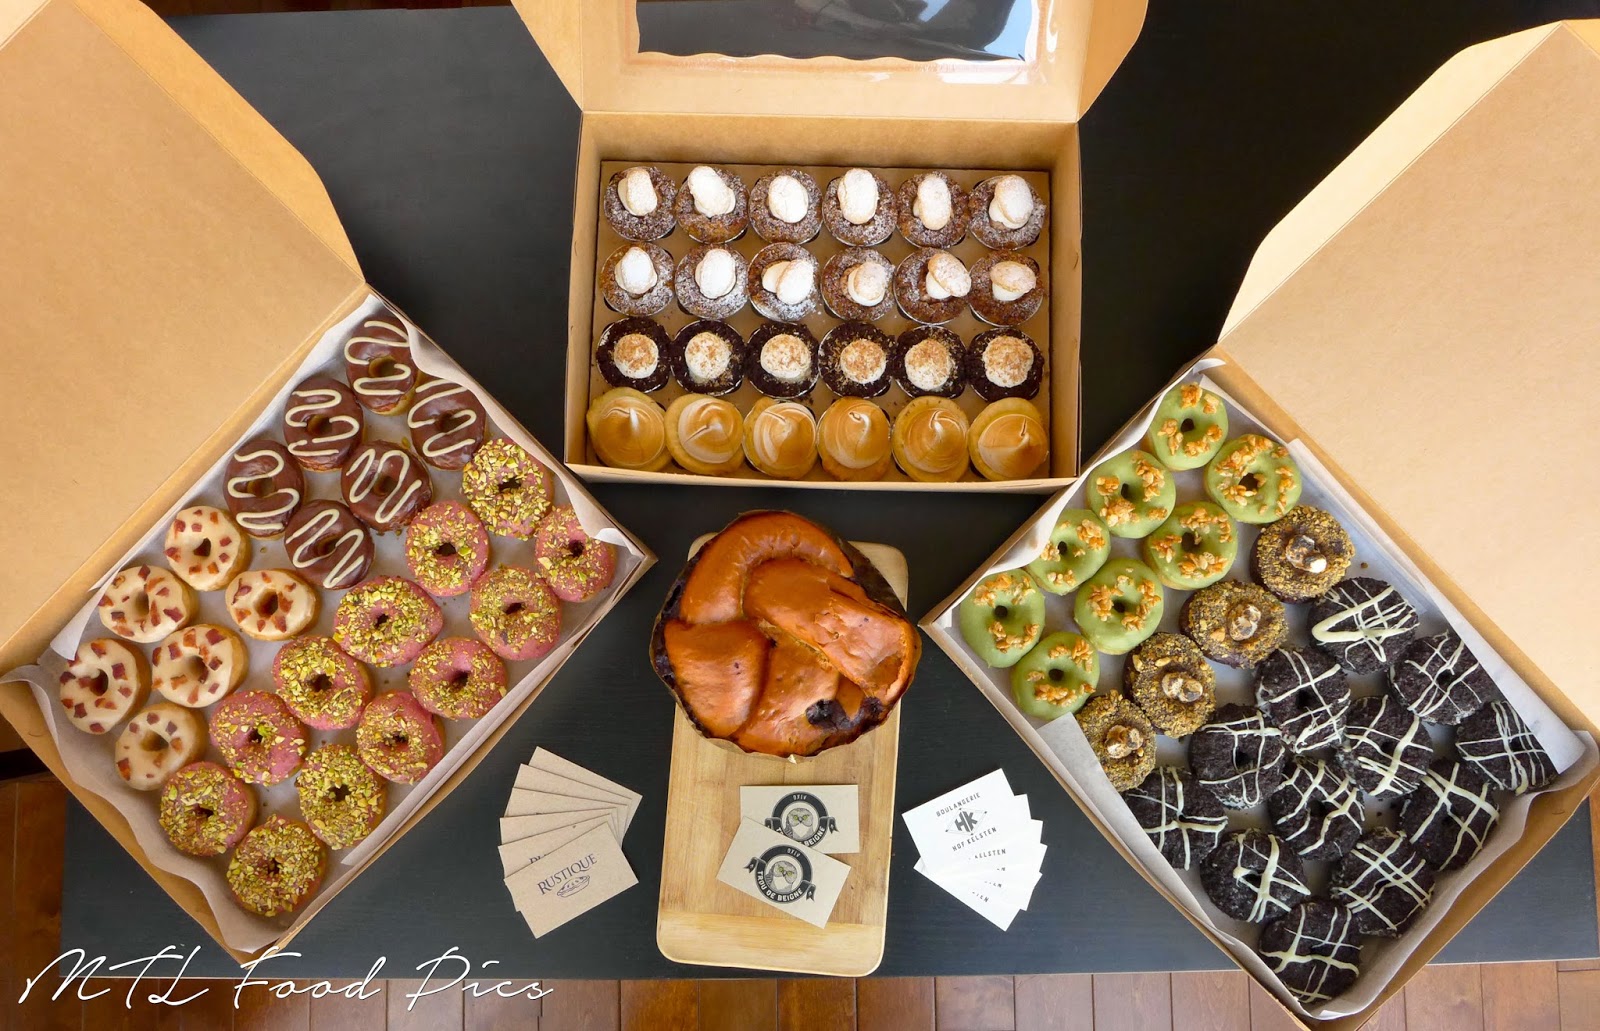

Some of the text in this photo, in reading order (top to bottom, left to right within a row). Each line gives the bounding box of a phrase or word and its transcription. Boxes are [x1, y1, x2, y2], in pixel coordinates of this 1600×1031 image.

[935, 792, 981, 817] BOULANGERIE
[954, 811, 978, 832] HK
[952, 827, 997, 851] HOF KELSTEN
[537, 853, 598, 895] RUSTIQUE
[757, 870, 803, 901] TROU DE BEIGNE
